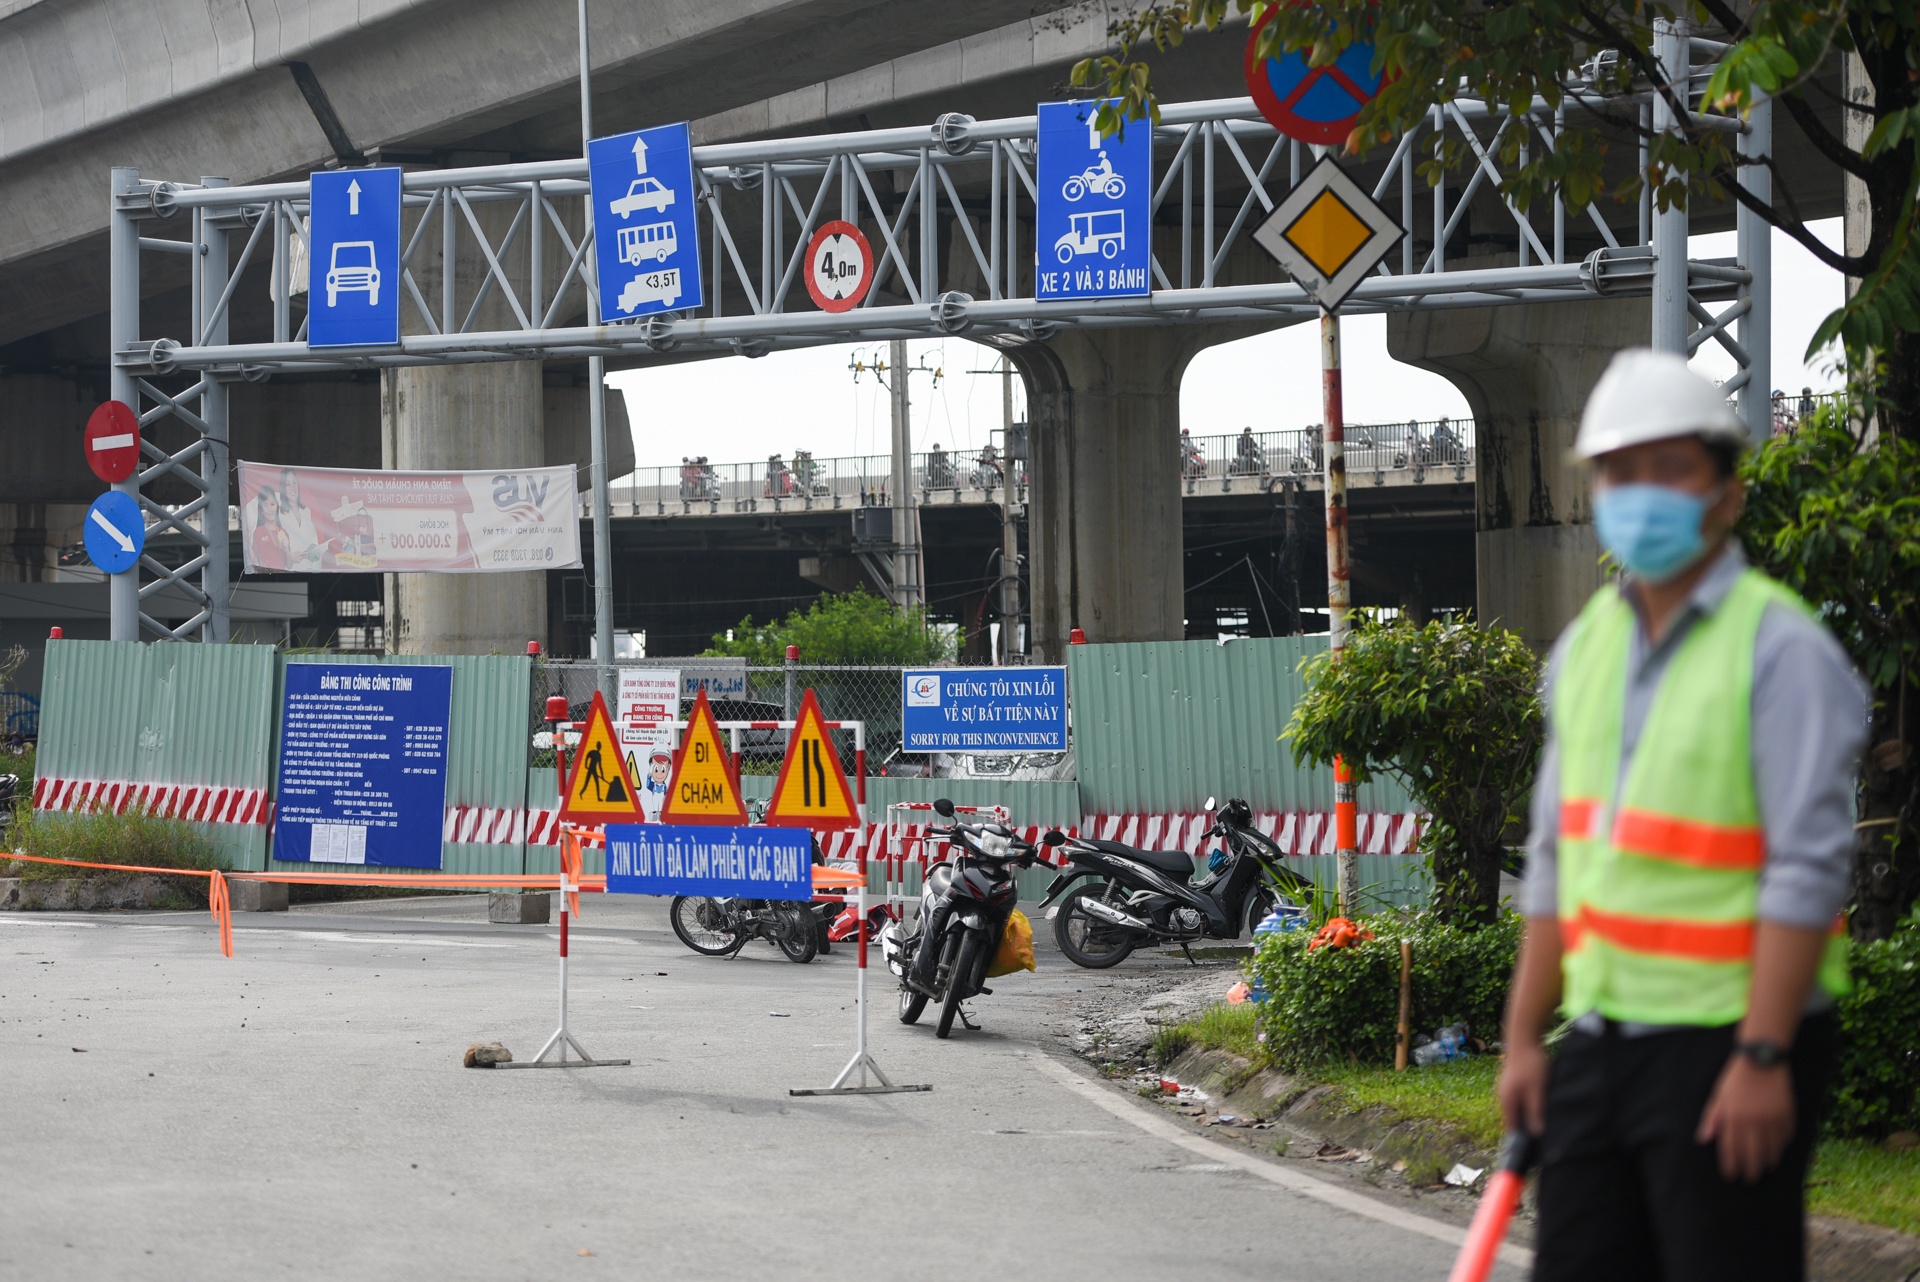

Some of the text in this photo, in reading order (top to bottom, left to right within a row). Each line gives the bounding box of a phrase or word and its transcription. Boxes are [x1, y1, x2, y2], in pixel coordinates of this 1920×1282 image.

[1042, 263, 1145, 292] XE 2 VÀ 3 BÁNH
[321, 671, 412, 691] BẢNG THI CÔNG CÔNG TRÌNH
[947, 679, 988, 697] CHÚNG
[990, 678, 1010, 697] TÔI
[1012, 682, 1032, 696] XIN
[1035, 674, 1056, 696] LỖI
[944, 701, 1059, 724] VỀ SỰ BẤT TIỆN NÀY
[911, 733, 1059, 746] SORRY FOR THIS INCONVENIENCE
[695, 742, 709, 763] ĐI
[682, 778, 723, 809] CHẬM
[612, 842, 631, 876] XIN
[633, 831, 652, 877] LỖI
[653, 835, 665, 878] VÌ
[667, 837, 684, 878] ĐÃ
[685, 836, 709, 879] LÀM
[712, 832, 746, 880] PHIỀN
[750, 837, 771, 881] CÁC
[774, 846, 798, 888] BẠN
